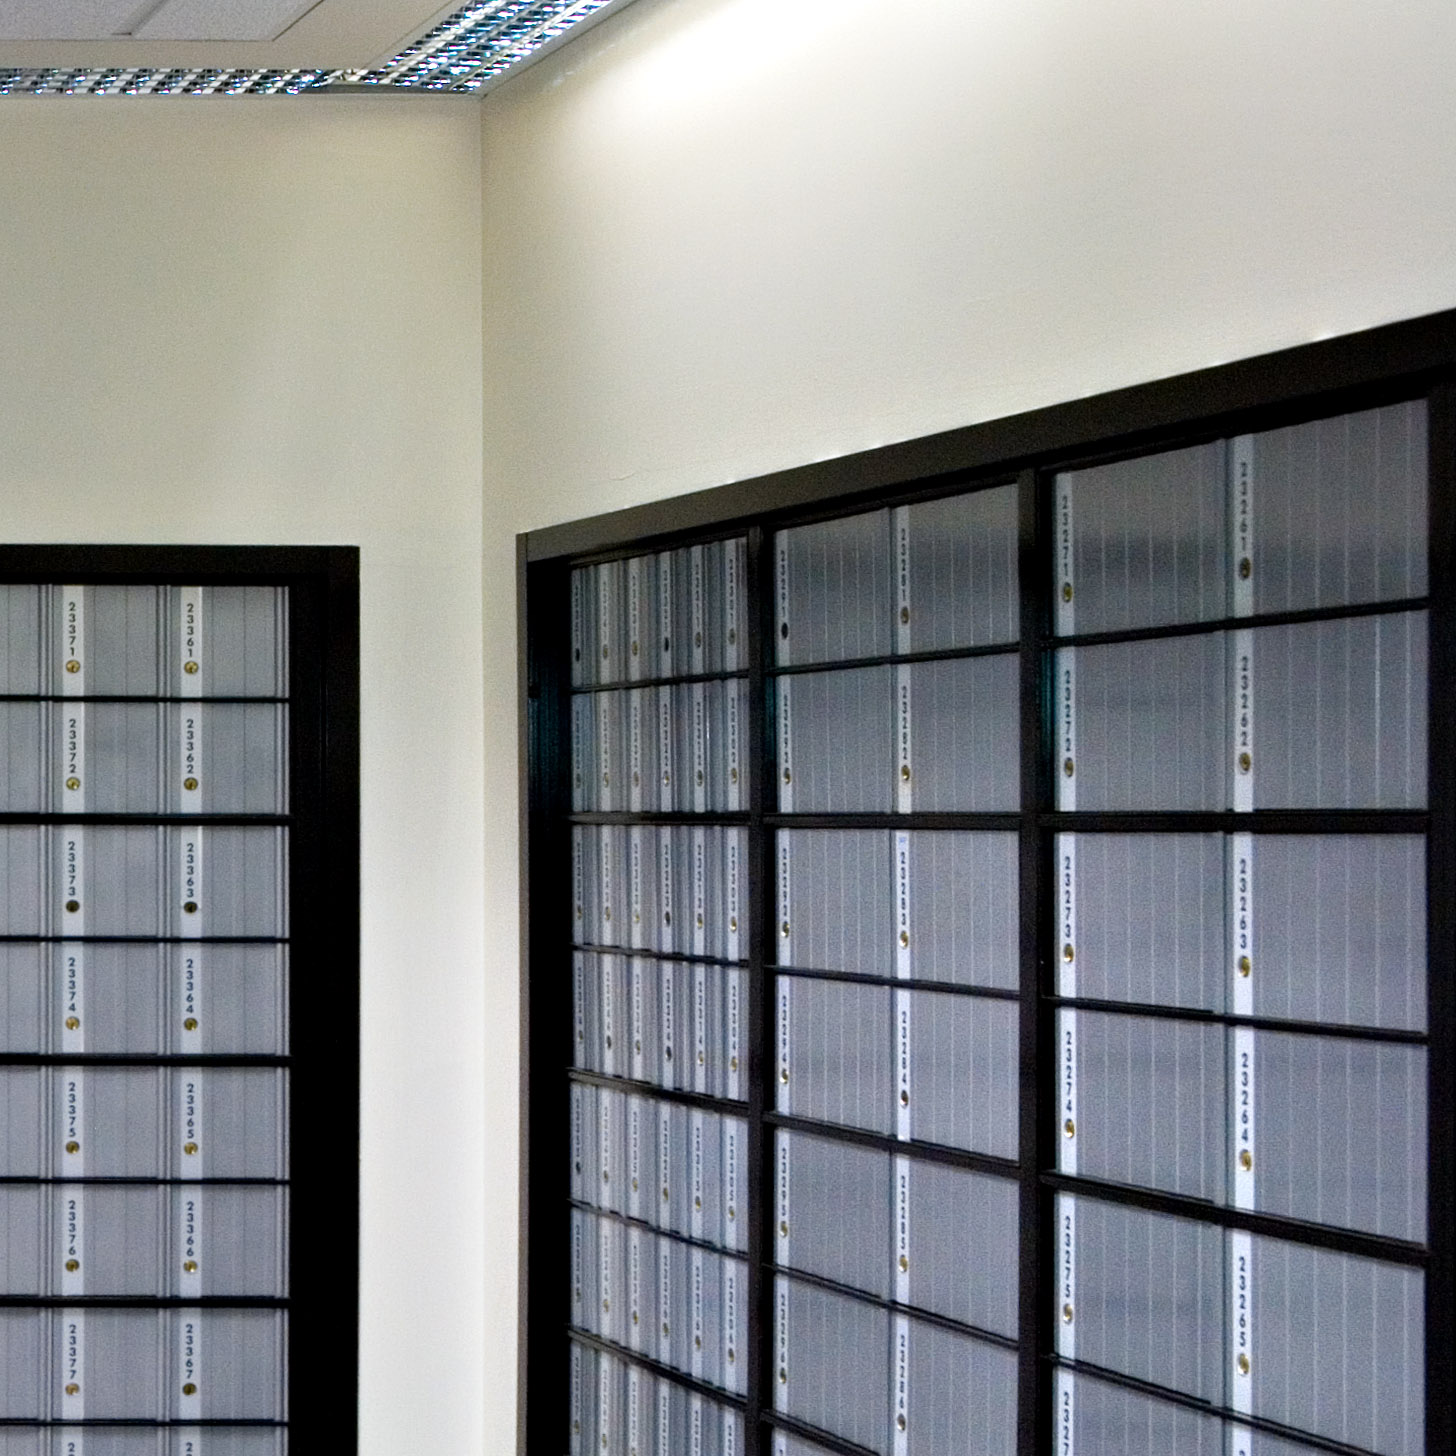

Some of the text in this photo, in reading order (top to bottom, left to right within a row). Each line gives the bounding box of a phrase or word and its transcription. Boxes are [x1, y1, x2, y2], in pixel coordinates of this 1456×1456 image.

[67, 601, 78, 656] 23371
[185, 719, 196, 774] 23362
[67, 841, 78, 896] 23373
[184, 959, 195, 1014] 23364
[66, 1082, 77, 1138] 23375
[184, 1201, 195, 1257] 23366
[67, 1324, 78, 1379] 23377
